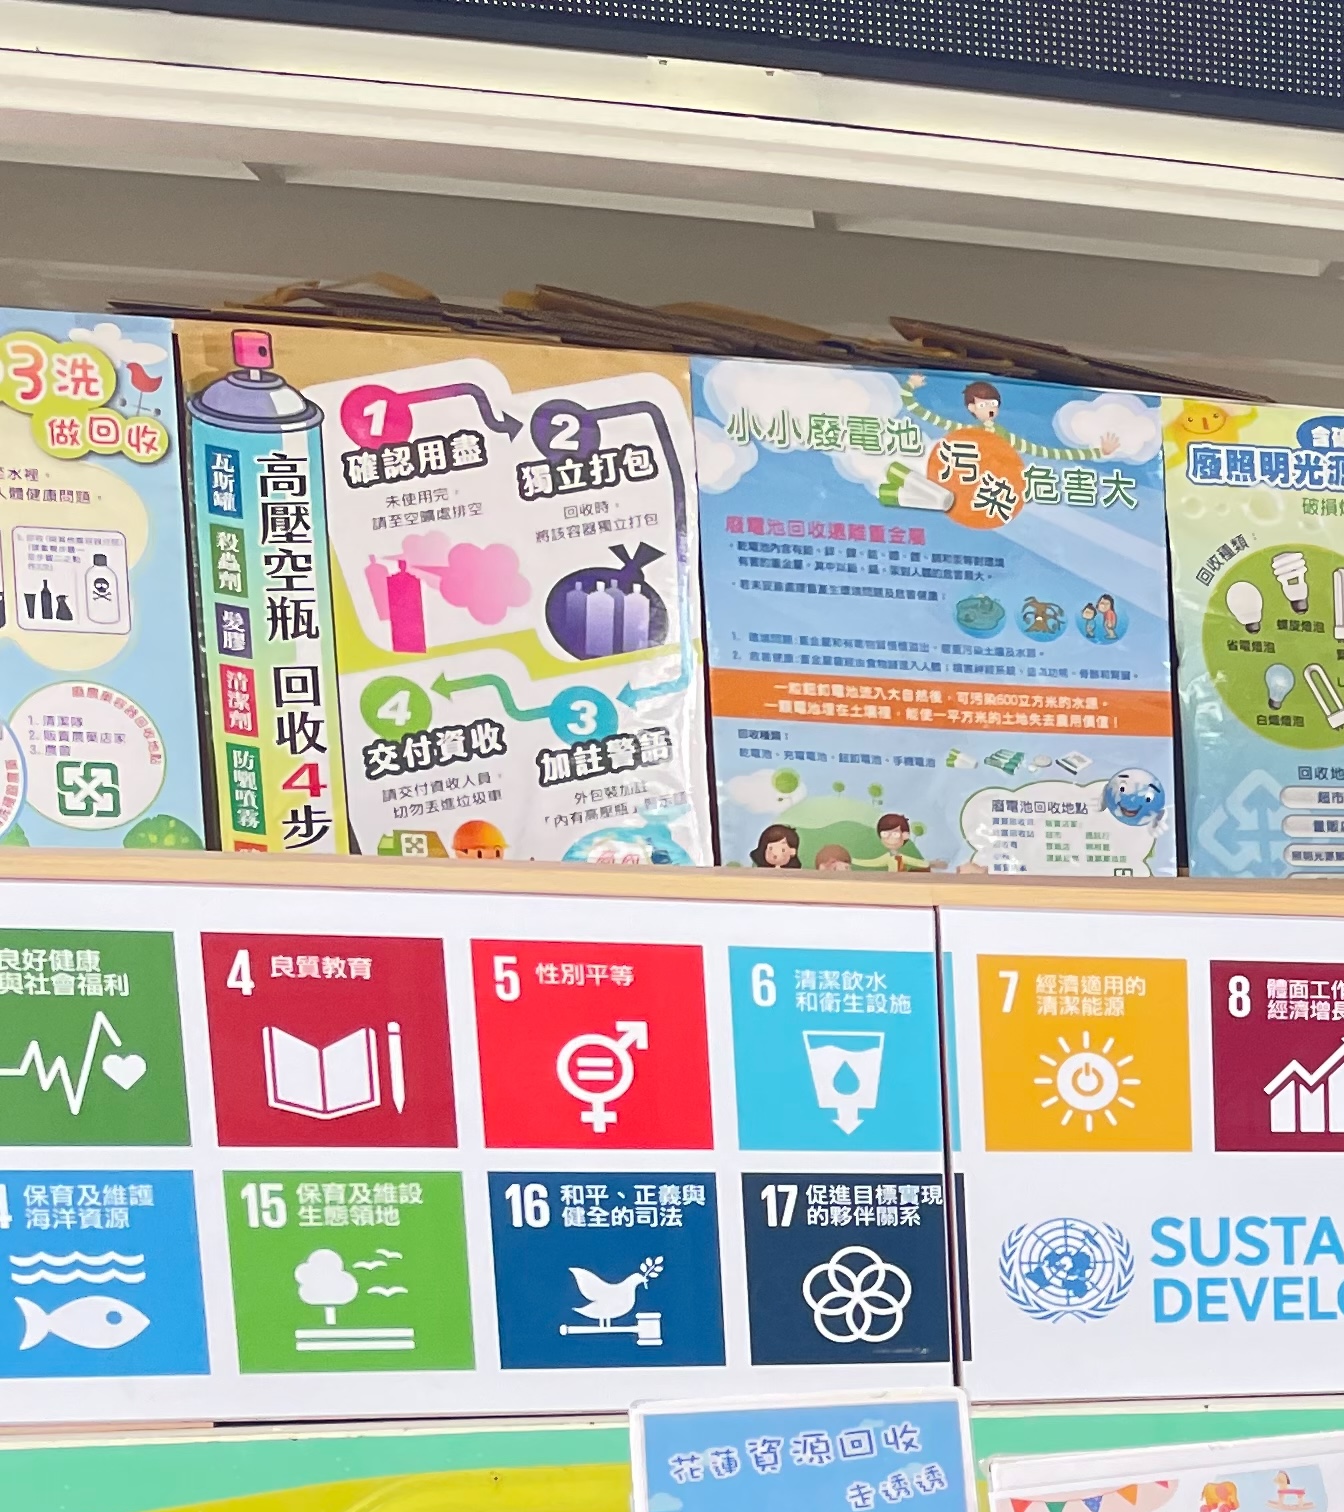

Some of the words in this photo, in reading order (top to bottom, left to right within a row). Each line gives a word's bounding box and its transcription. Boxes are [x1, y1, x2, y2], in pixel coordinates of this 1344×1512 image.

[49, 417, 160, 456] 做回收
[363, 400, 388, 437] 1
[549, 413, 581, 452] 2
[726, 407, 925, 454] 小小廢電池
[345, 434, 483, 486] 確認用盡
[521, 449, 654, 497] 獨立打包
[938, 441, 1019, 522] 污染
[1023, 464, 1138, 509] 危害大
[256, 453, 320, 641] 高壓空瓶
[377, 691, 411, 726] 4
[566, 700, 598, 735] 3
[273, 665, 333, 850] 回收4步
[367, 722, 504, 775] 交付資收
[540, 730, 672, 781] 加註警語
[226, 949, 255, 997] 4
[493, 956, 521, 1002] 5
[535, 963, 634, 986] 性別平等
[751, 963, 776, 1008] 6
[794, 970, 888, 991] 清潔飲水
[998, 970, 1019, 1014] 7
[1035, 974, 1146, 997] 經濟適用的
[794, 992, 912, 1015] 和衛生設施
[1036, 996, 1125, 1017] 清潔能源
[1228, 974, 1252, 1018] 8
[240, 1183, 288, 1228] 15
[504, 1183, 550, 1228] 16
[560, 1185, 705, 1207] 和平、正義與
[561, 1207, 683, 1227] 健全的司法
[760, 1184, 797, 1227] 17
[805, 1185, 942, 1206] 促進目標實現
[25, 1207, 129, 1230] 海洋資源
[670, 1422, 922, 1483] 花蓮資源回收
[847, 1463, 948, 1511] 走透透
